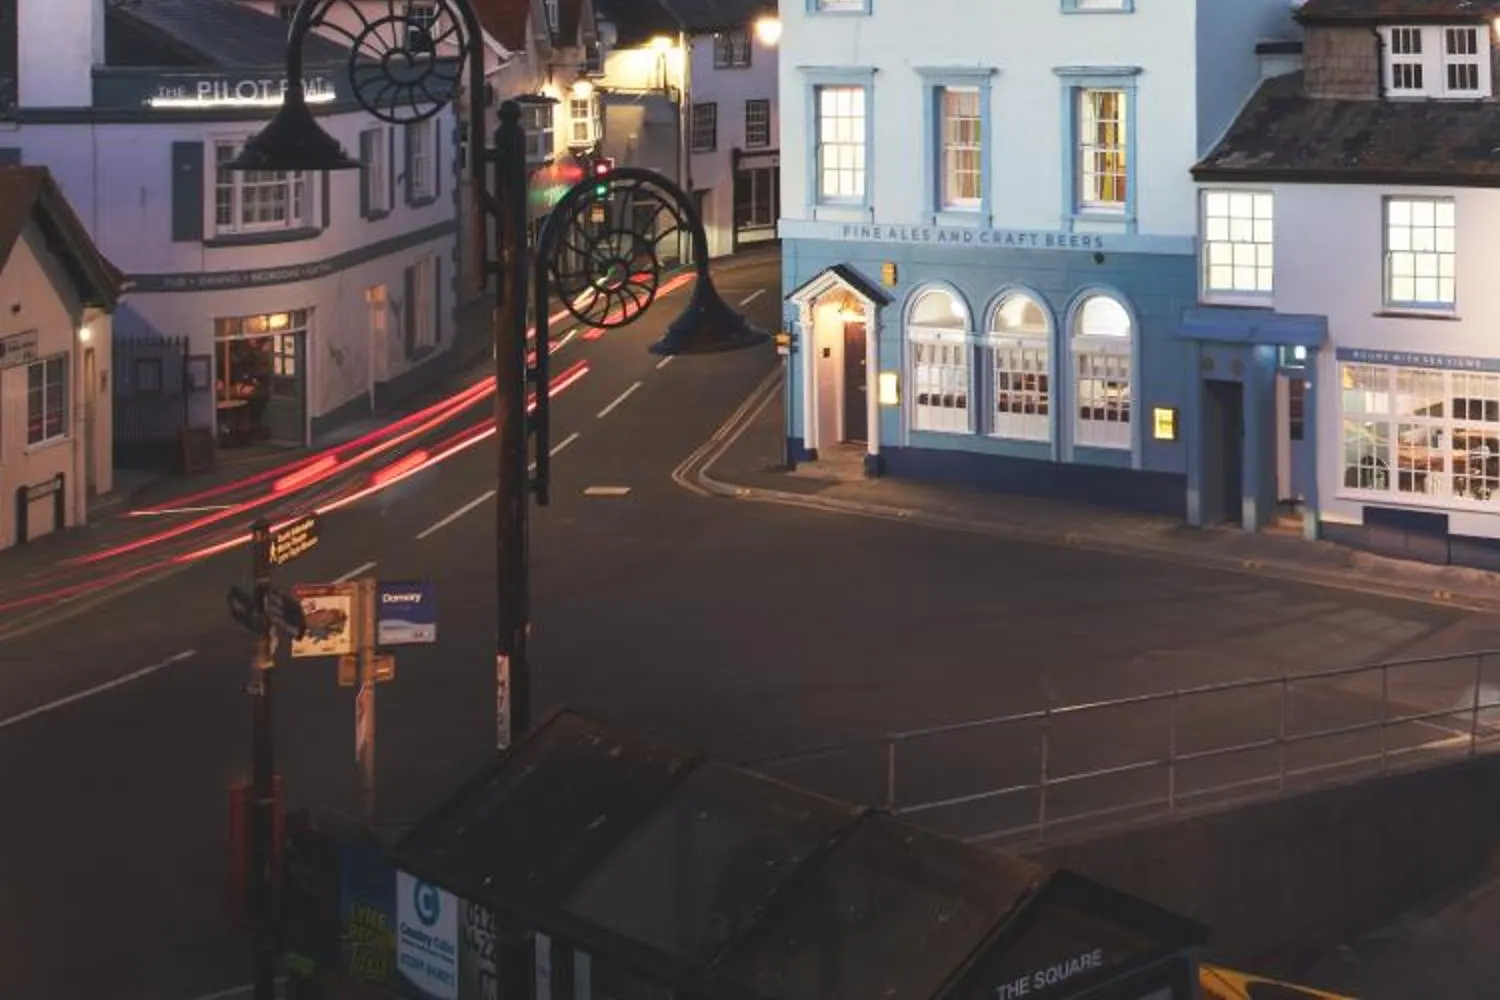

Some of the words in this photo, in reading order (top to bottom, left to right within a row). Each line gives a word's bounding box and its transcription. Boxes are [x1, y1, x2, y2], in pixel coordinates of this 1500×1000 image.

[158, 85, 187, 99] THE
[197, 80, 272, 100] PILOT
[843, 226, 881, 239] FINE
[889, 227, 930, 241] ALES
[937, 230, 972, 243] AND
[980, 231, 1038, 246] CRAFT
[1045, 234, 1104, 249] BEERS
[997, 976, 1030, 1000] THE
[1033, 948, 1102, 989] SQUARE
